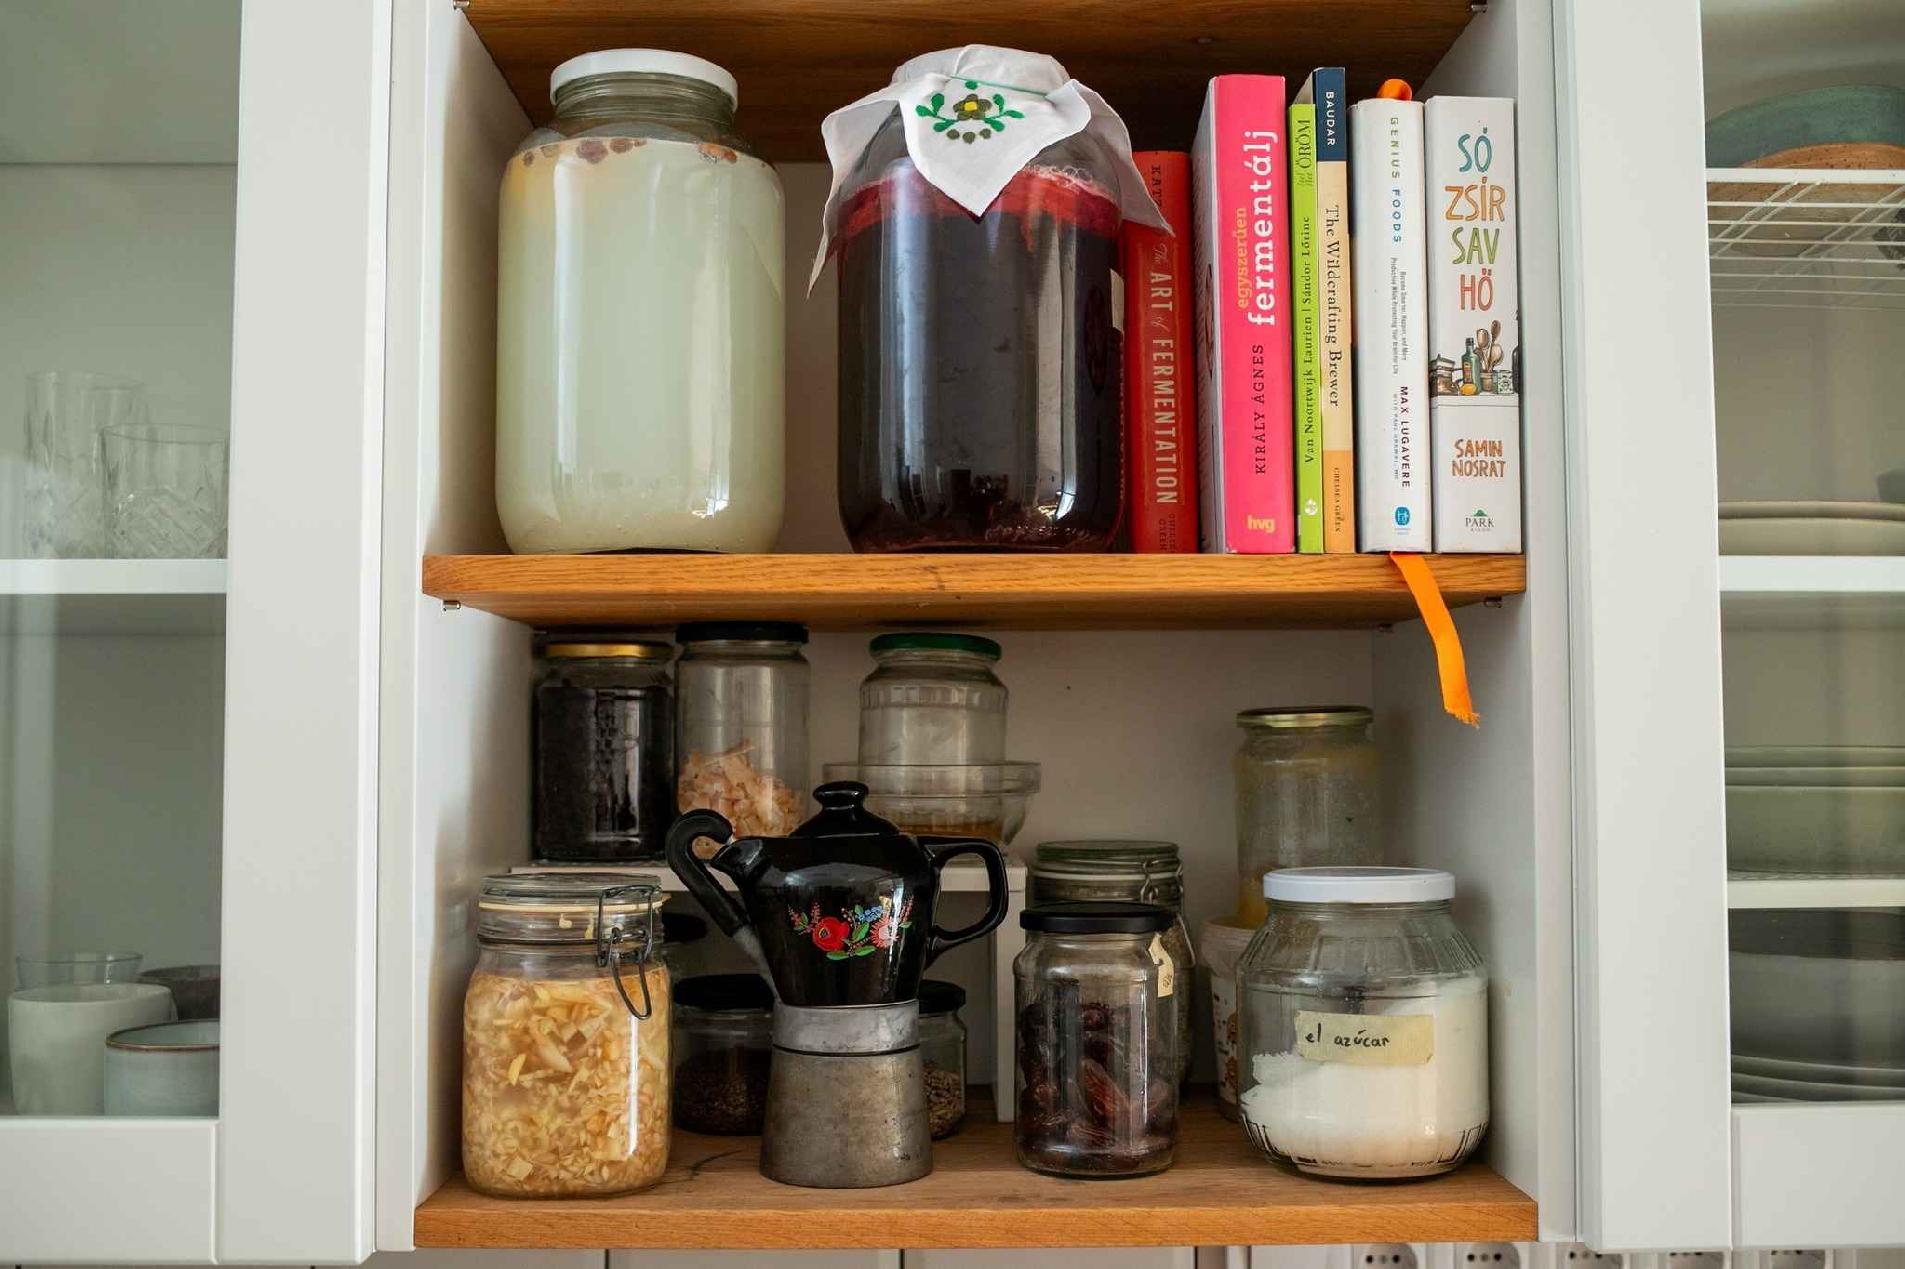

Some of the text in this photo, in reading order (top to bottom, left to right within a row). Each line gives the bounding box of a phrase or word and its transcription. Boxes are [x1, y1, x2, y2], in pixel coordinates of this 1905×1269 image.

[1325, 91, 1335, 146] BAUDAR
[1295, 120, 1312, 168] ÖRÖM
[1458, 126, 1492, 173] SÓ
[1390, 117, 1402, 243] GENIUS FOODS
[1445, 176, 1505, 222] ZSÍR
[1243, 130, 1277, 326] fermentálj
[1452, 226, 1500, 265] SAV
[1234, 207, 1251, 308] egyszerűen
[1151, 272, 1172, 312] ART
[1300, 261, 1312, 304] Sándor
[1325, 205, 1342, 407] The Wildcrafting Brewer
[1460, 268, 1493, 311] HÖ
[1302, 316, 1312, 363] Laurien
[1152, 339, 1177, 504] FERMENTATION
[1248, 344, 1267, 474] KIRÁLY ÁGNES
[1303, 368, 1316, 434] Noortwijk
[1304, 439, 1314, 463] Van
[1400, 386, 1410, 488] MAX LUGAVERE
[1455, 439, 1502, 458] SAMIN
[1452, 460, 1506, 477] NOSRAT
[1247, 515, 1275, 534] hvg
[1465, 517, 1494, 528] PARK
[1305, 1023, 1390, 1047] el azúcar
